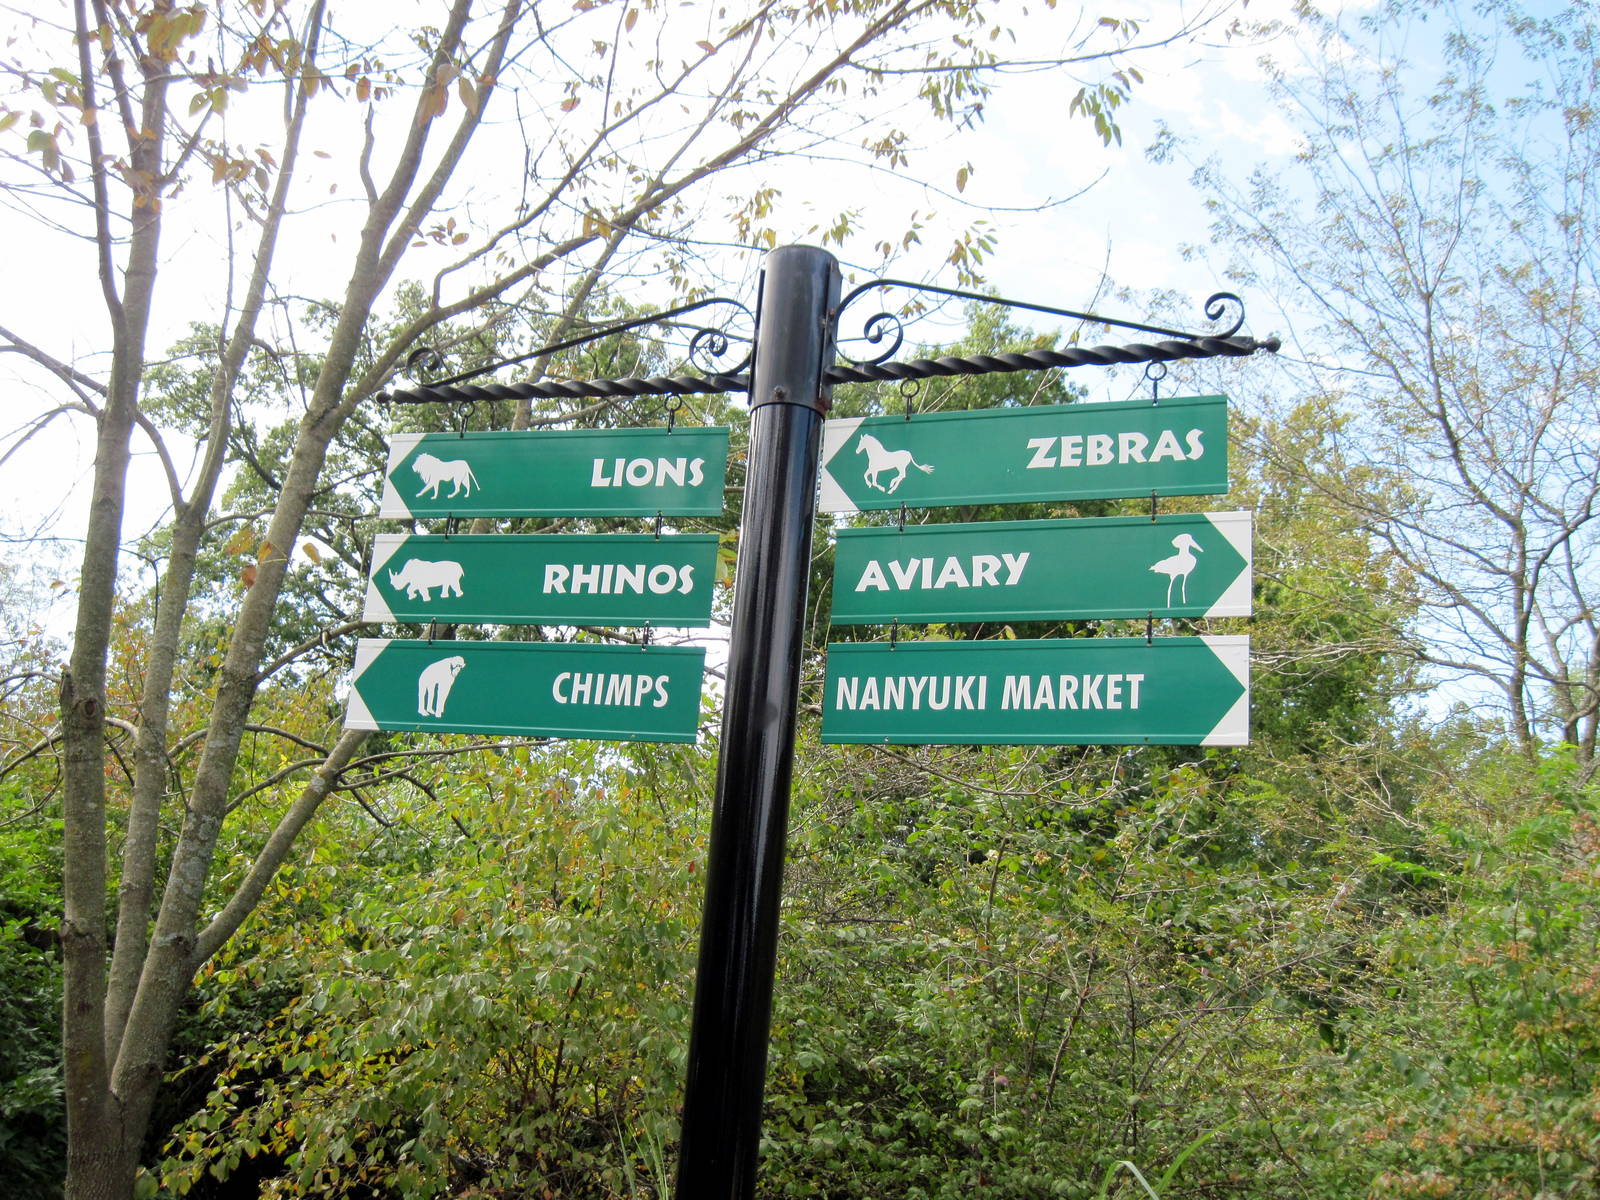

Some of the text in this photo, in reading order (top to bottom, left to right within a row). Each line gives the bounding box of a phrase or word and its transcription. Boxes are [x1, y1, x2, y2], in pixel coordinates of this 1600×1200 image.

[1025, 428, 1205, 470] ZEBRAS
[590, 457, 706, 489] LIONS
[542, 563, 695, 595] RHINOS
[854, 551, 1031, 593] AVIARY
[552, 671, 670, 708] CHIMPS
[835, 673, 1145, 711] NANYUKI MARKET
